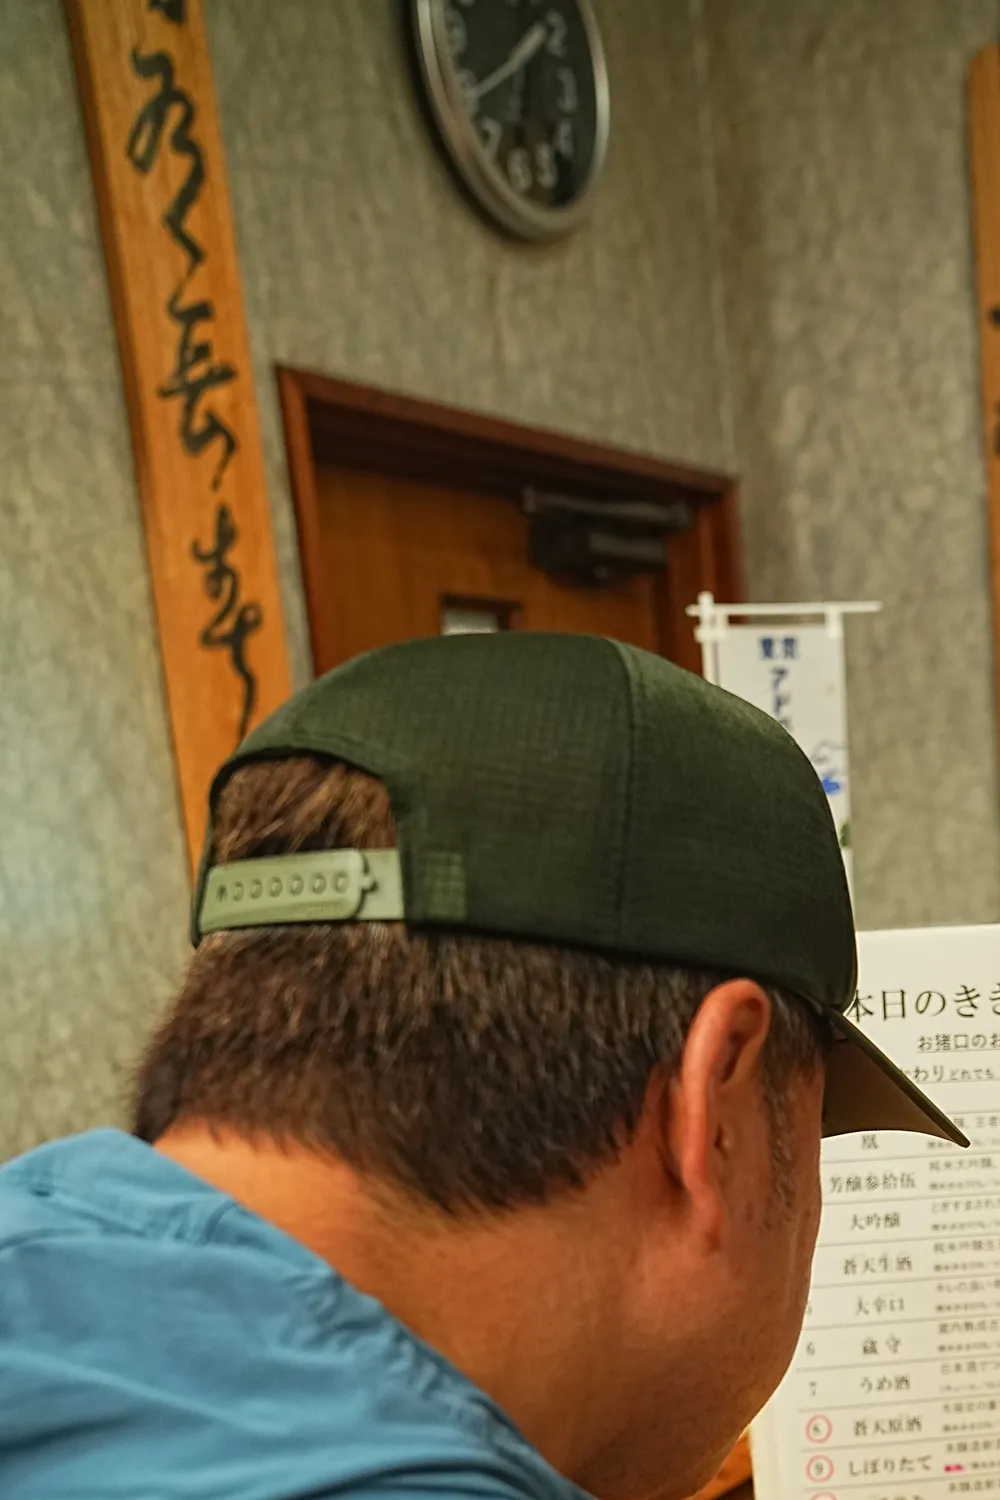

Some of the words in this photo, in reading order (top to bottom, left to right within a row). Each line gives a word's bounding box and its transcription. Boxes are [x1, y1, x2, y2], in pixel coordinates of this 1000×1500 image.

[850, 1212, 901, 1231] 大吟醸
[855, 1294, 905, 1316] 大辛口
[860, 1374, 911, 1394] うめ酒
[814, 1462, 824, 1477] 9
[849, 1455, 932, 1476] しぼりたて
